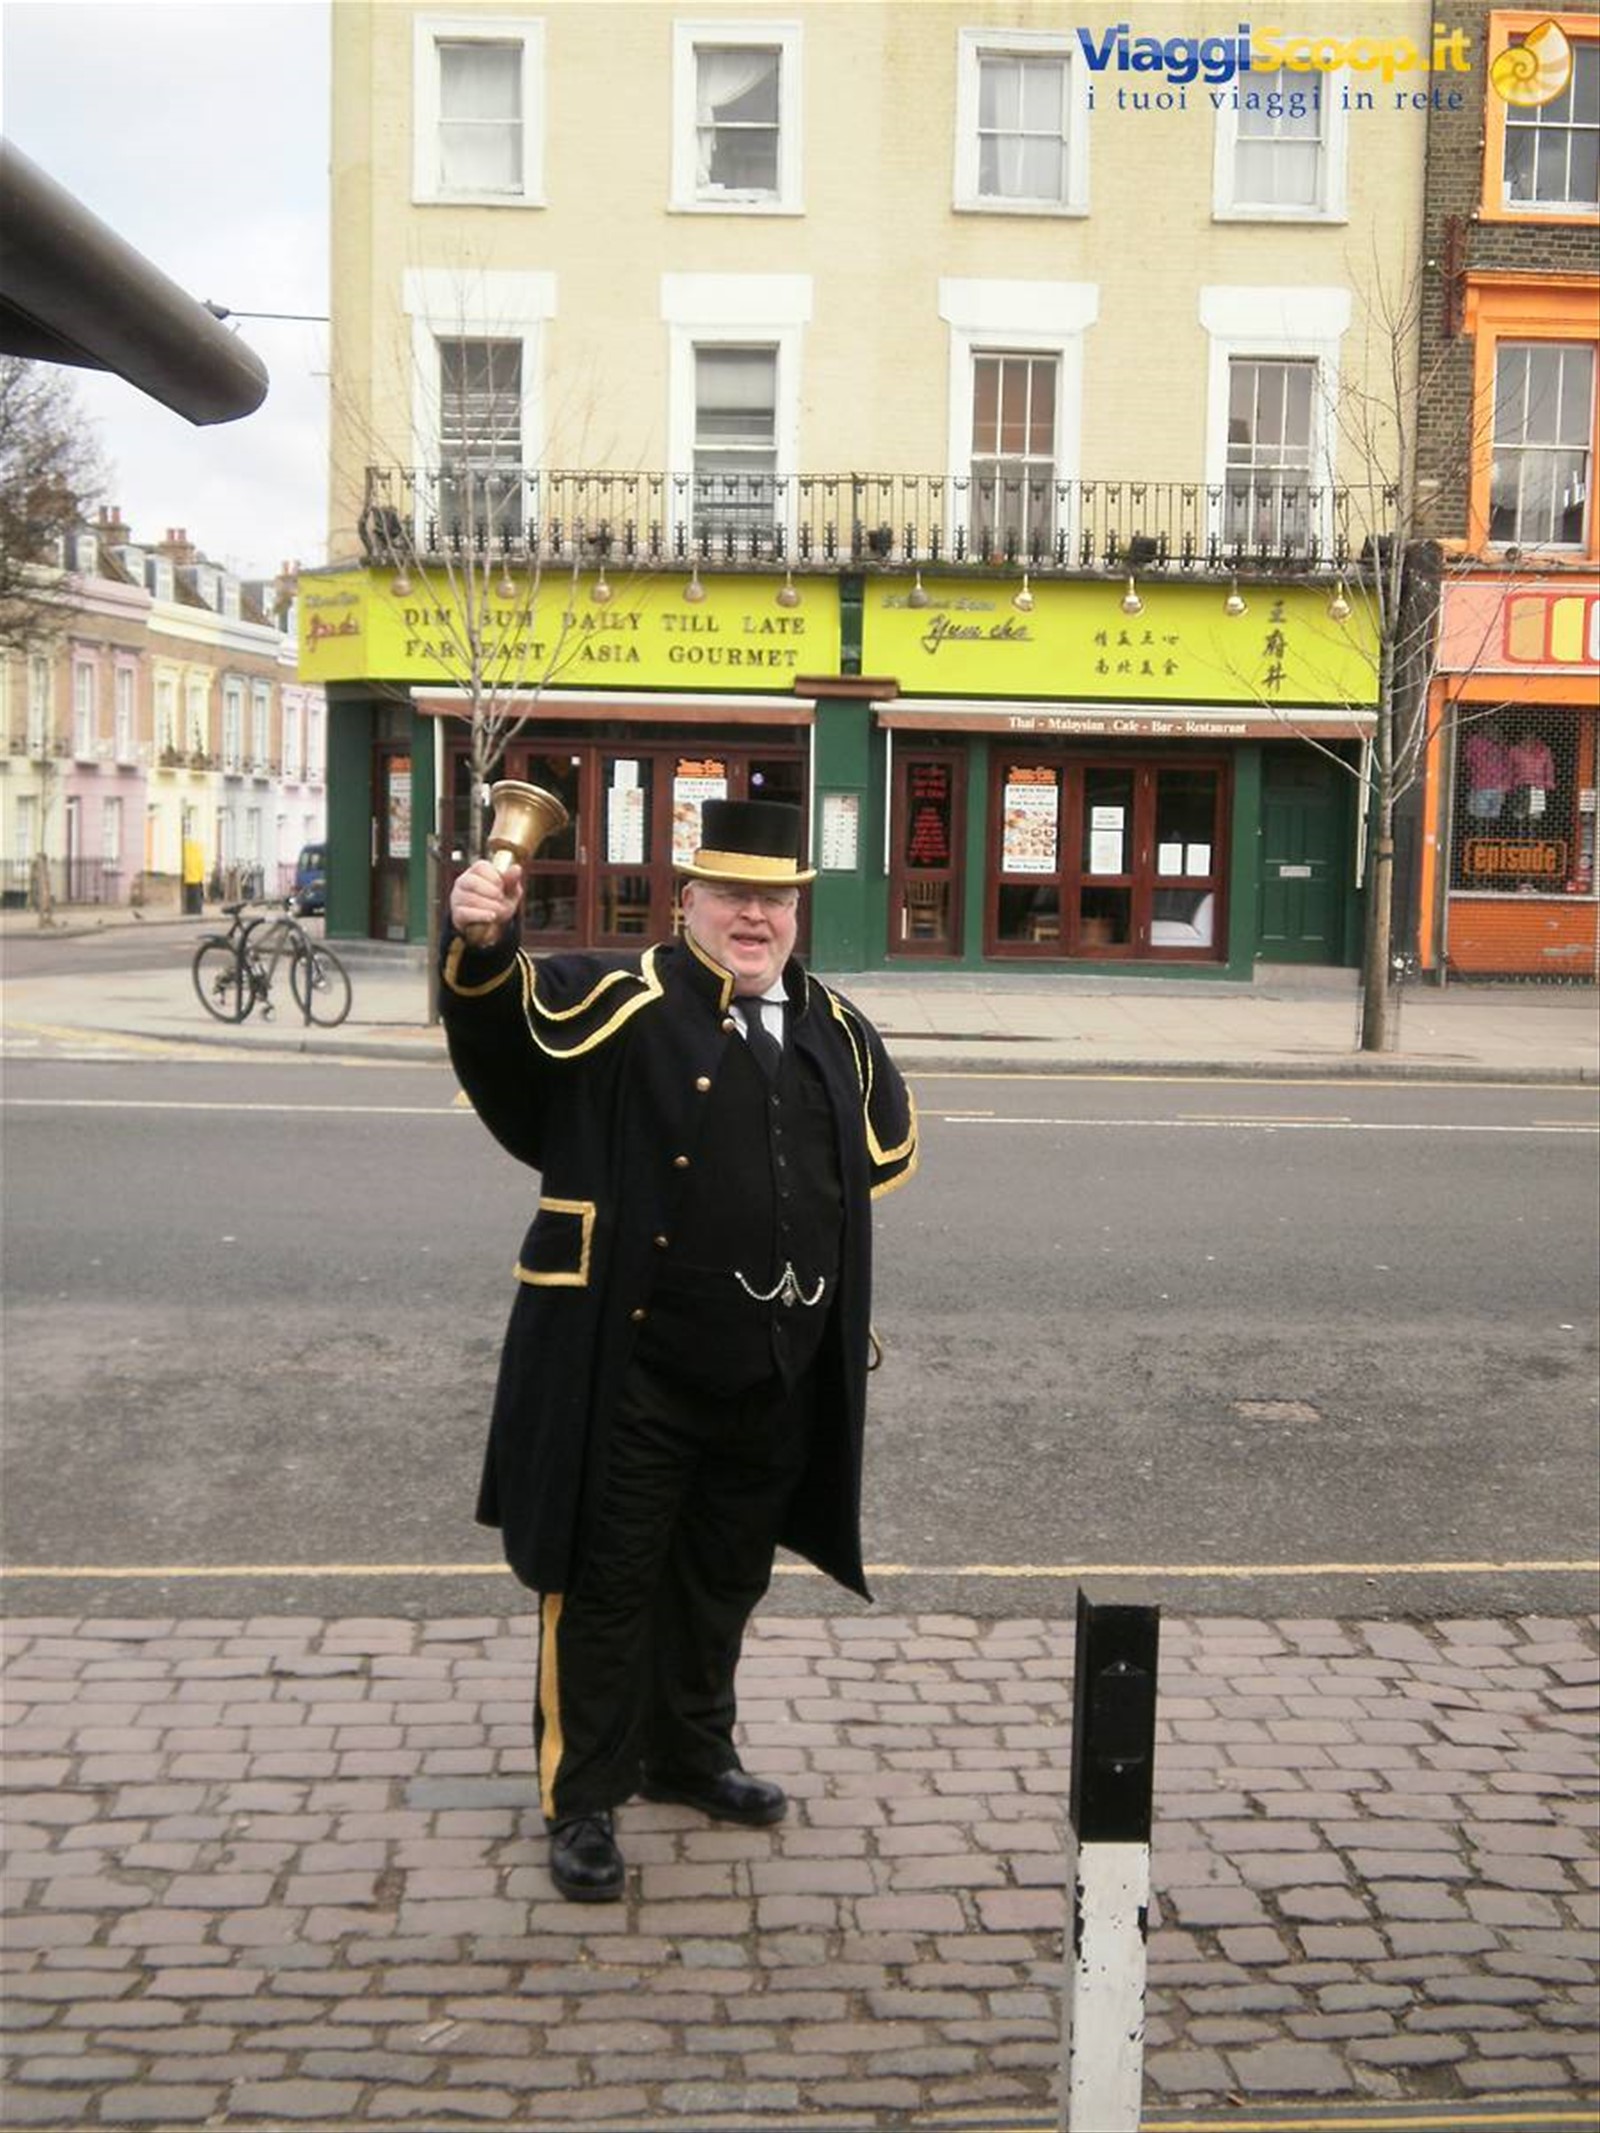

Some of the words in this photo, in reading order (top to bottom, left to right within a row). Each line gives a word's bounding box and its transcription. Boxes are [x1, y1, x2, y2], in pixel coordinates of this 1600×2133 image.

[404, 608, 452, 626] DIM
[482, 609, 533, 628] SUM
[562, 611, 642, 631] DAILY
[661, 613, 720, 633] TILL
[743, 616, 806, 635] LATE
[404, 639, 455, 658] FAR
[478, 641, 545, 660] EAST
[580, 643, 641, 662] ASIA
[668, 645, 798, 667] GOURMET
[1009, 716, 1036, 730] Thai
[1048, 717, 1105, 734] Malaysian
[1152, 719, 1173, 733] Bar
[1185, 720, 1247, 734] Restaurant
[1474, 841, 1556, 876] episode
